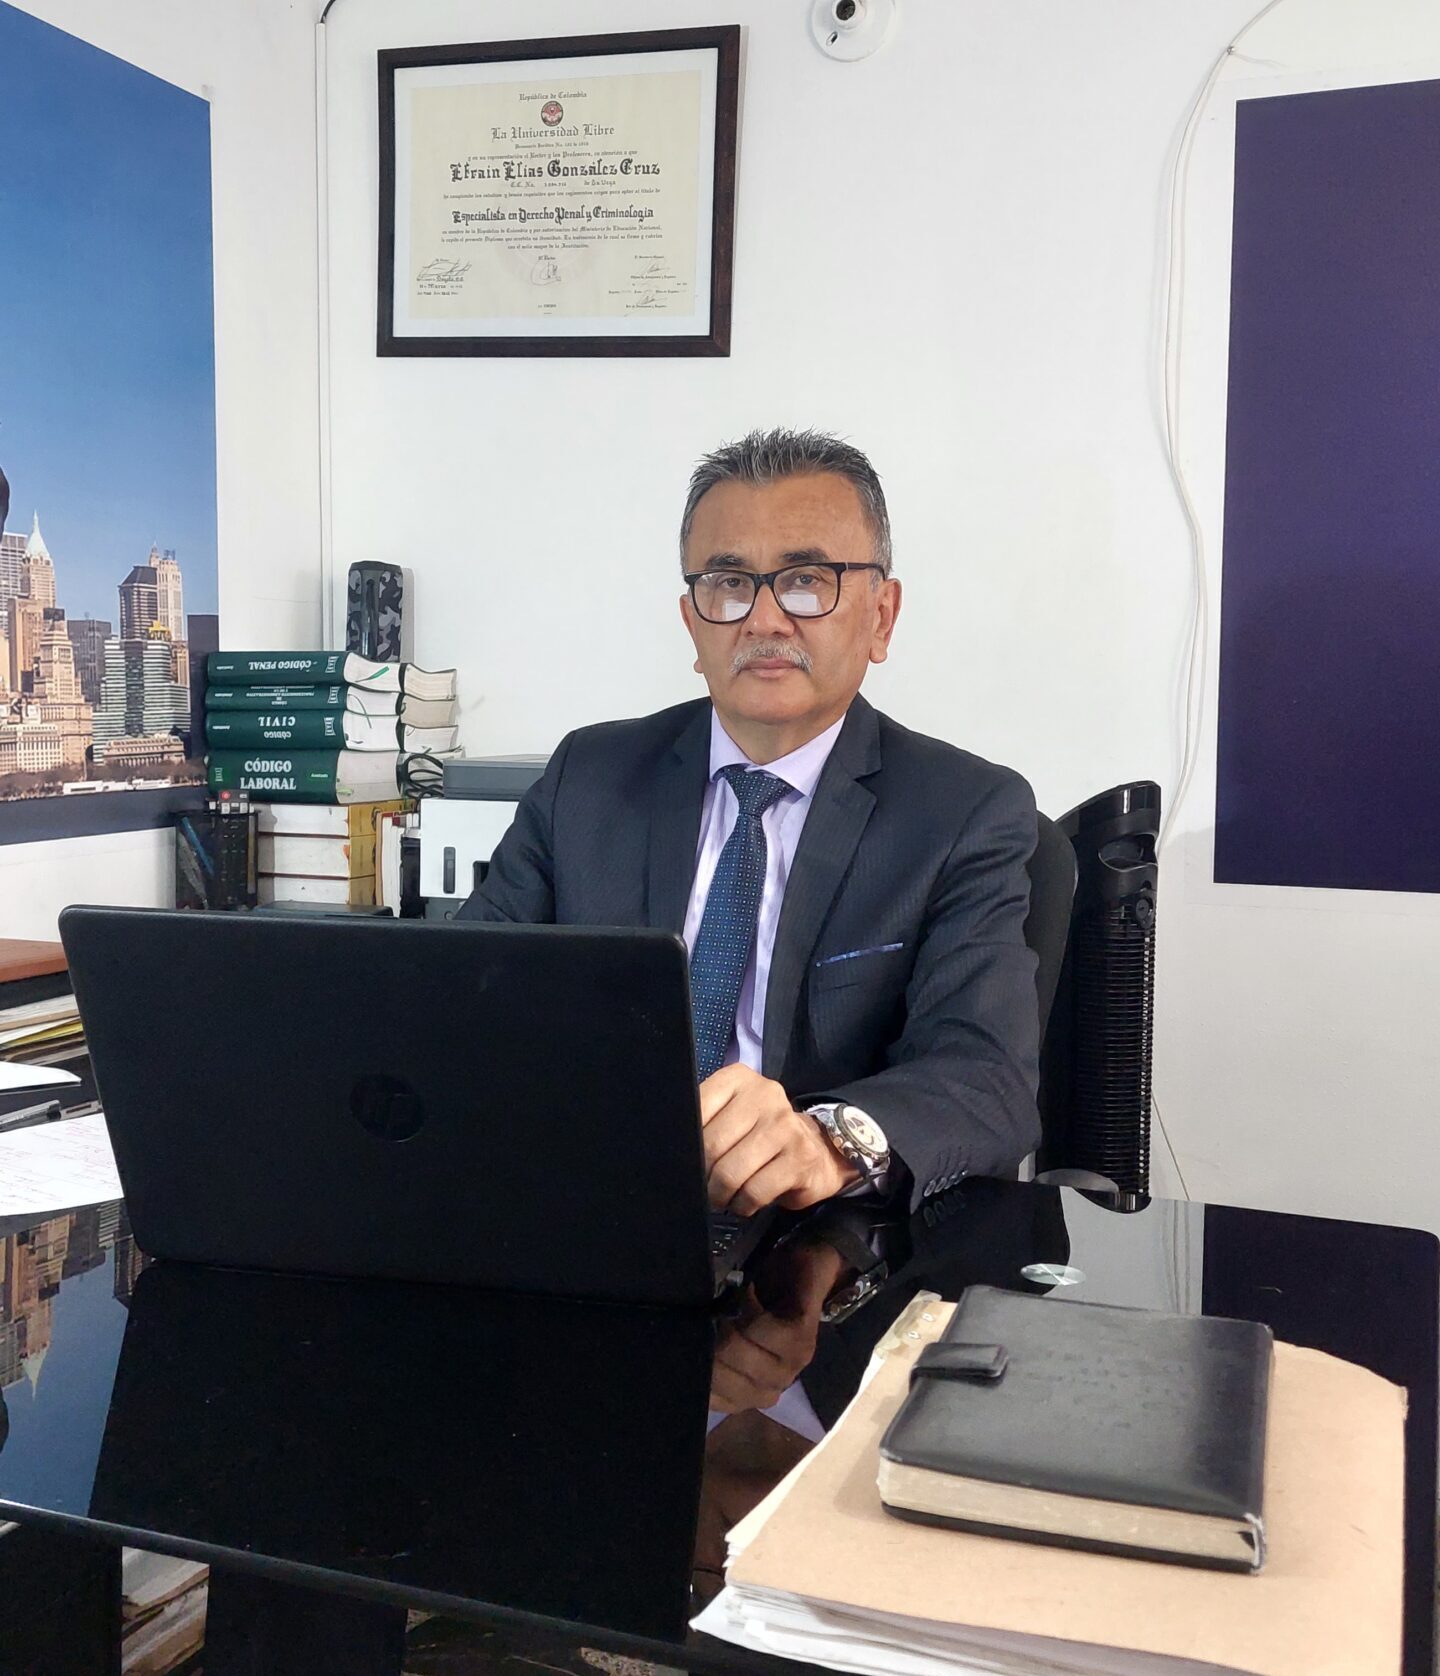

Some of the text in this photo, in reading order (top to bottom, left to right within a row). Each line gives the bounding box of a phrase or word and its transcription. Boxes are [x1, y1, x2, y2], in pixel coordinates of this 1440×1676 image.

[491, 124, 615, 142] La Universidad Libre
[547, 158, 618, 177] González
[620, 158, 660, 176] Cruz
[452, 206, 506, 226] Especialista
[508, 212, 517, 220] en
[519, 206, 554, 223] Derecho
[555, 204, 584, 225] Penal
[586, 211, 592, 223] y
[248, 660, 312, 671] CÓDIGO PENAL
[258, 716, 296, 727] CIVIL
[264, 731, 292, 740] CÓDIGO
[244, 757, 292, 772] CÓDIGO
[240, 778, 296, 790] LABORAL
